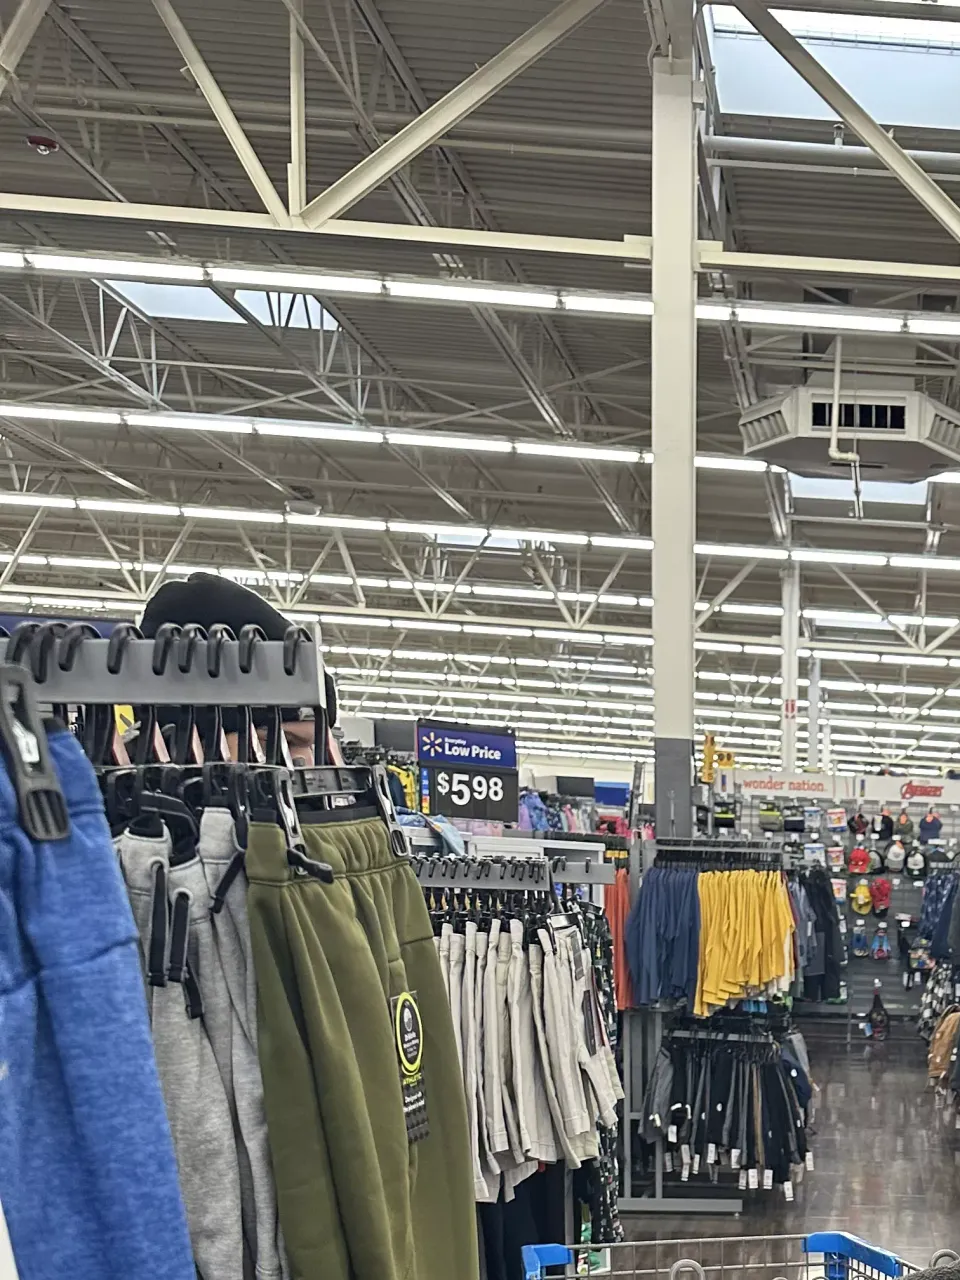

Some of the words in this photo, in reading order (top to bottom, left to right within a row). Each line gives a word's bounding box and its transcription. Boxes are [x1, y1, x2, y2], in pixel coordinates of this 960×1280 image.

[445, 743, 470, 756] Low
[471, 745, 502, 760] Price
[743, 775, 785, 790] wonder
